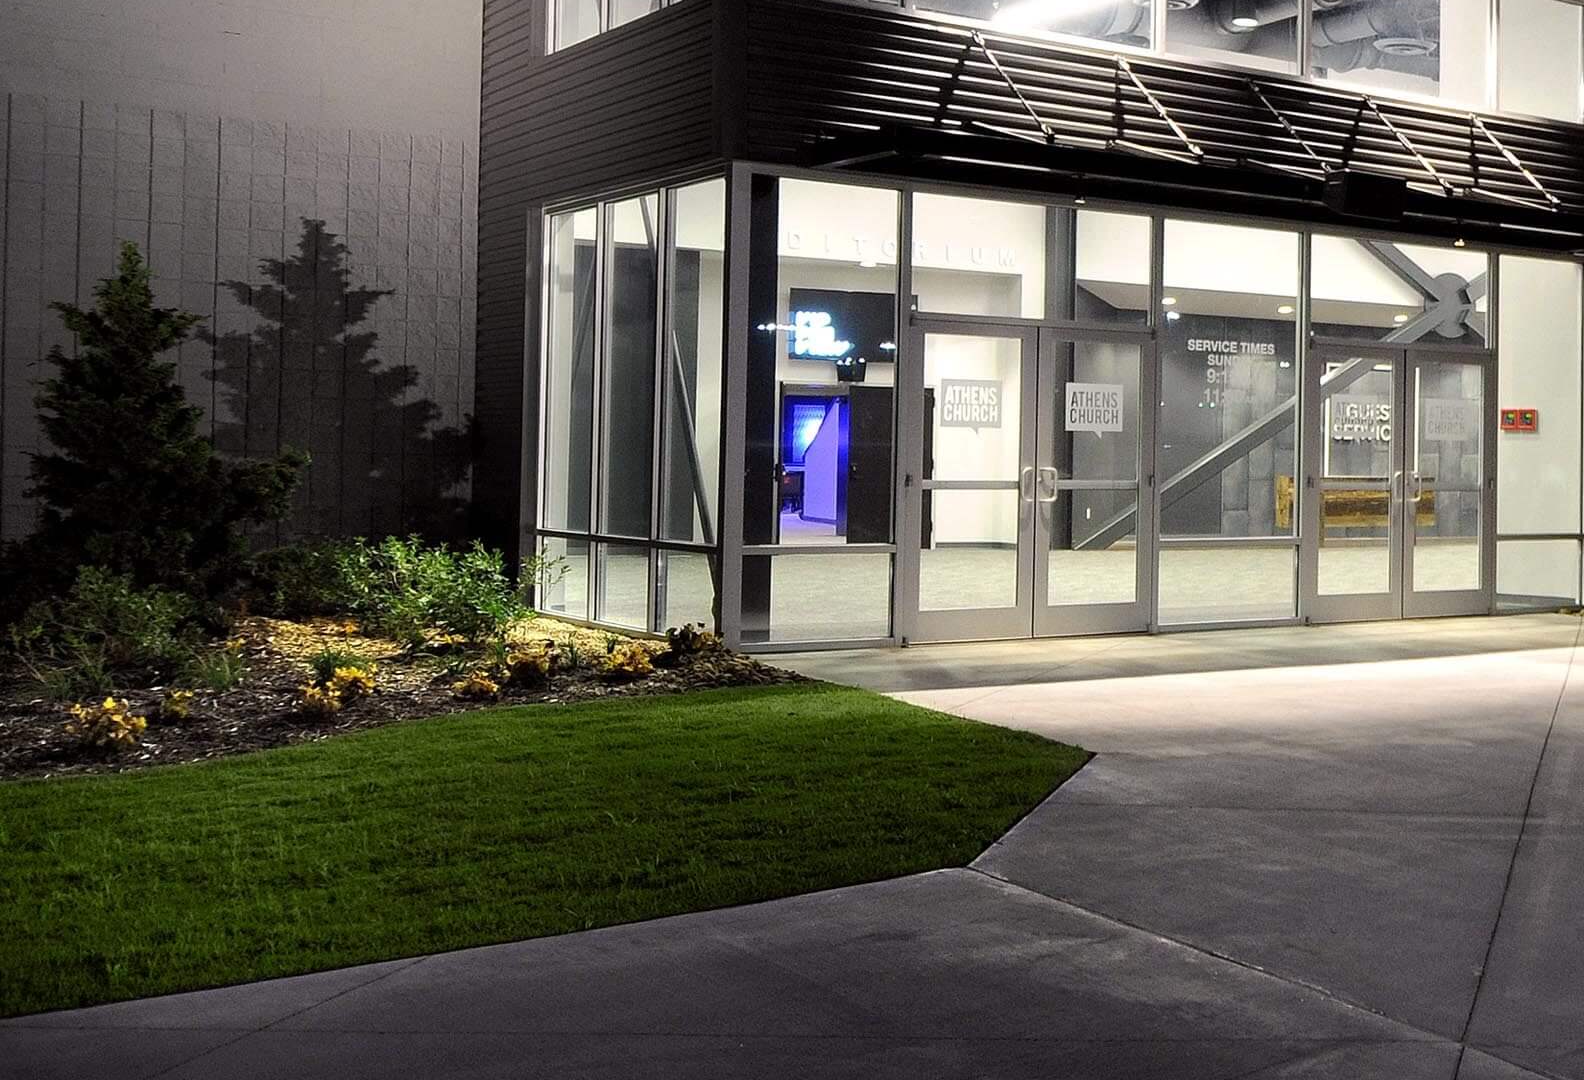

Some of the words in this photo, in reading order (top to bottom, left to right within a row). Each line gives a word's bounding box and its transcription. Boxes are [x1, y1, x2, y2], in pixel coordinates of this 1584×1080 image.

[786, 231, 1016, 266] DITORIUM
[1187, 339, 1238, 353] SERVICE
[1240, 342, 1275, 355] TIMES
[945, 385, 998, 405] ATHENS
[1070, 391, 1118, 409] ATHENS
[943, 404, 999, 422] CHURCH
[1069, 408, 1119, 425] CHURCH
[1345, 403, 1391, 422] GUES
